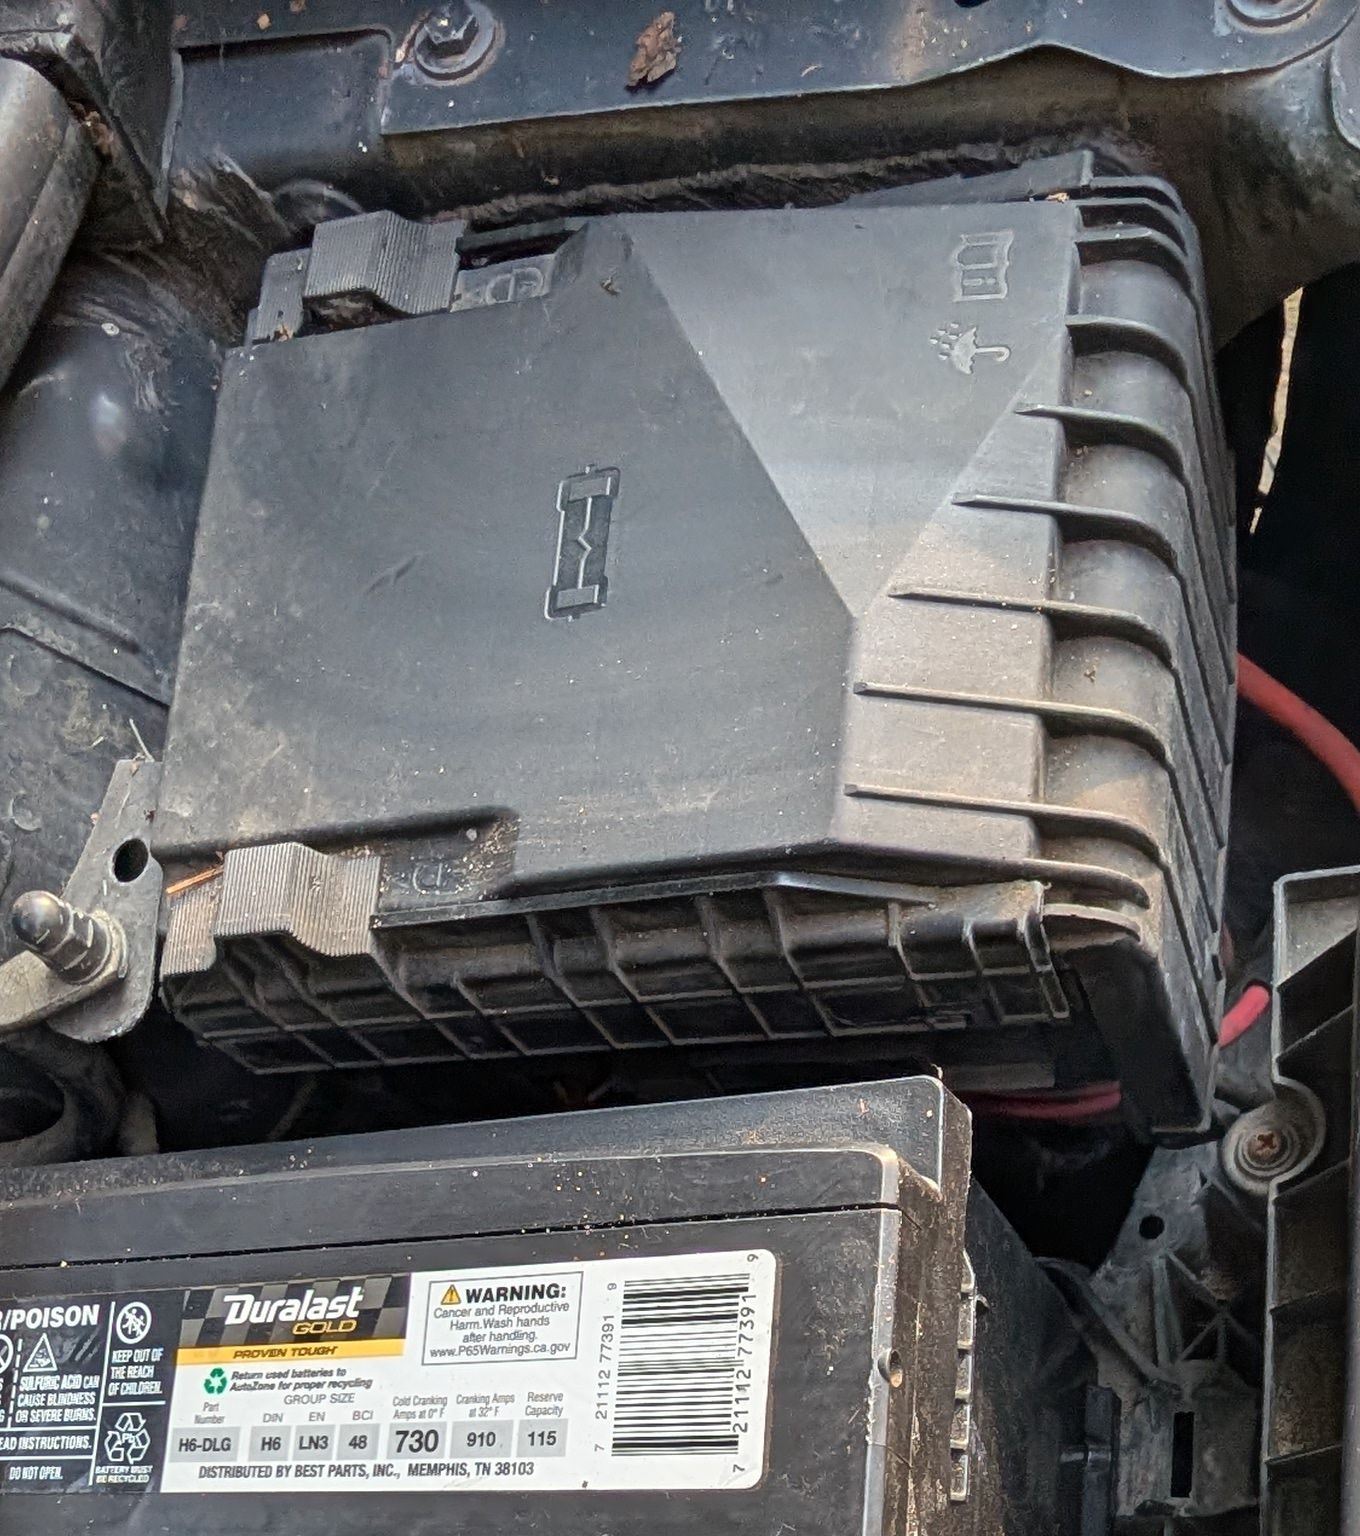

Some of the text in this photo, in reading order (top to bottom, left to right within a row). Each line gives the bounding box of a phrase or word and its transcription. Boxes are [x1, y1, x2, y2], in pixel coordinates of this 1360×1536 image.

[466, 1283, 566, 1303] WARNING:
[223, 1286, 366, 1325] Duralast
[434, 1301, 570, 1318] Cancer and Reproductive
[292, 1319, 357, 1335] GOLD
[517, 1316, 550, 1327] hands
[463, 1330, 538, 1343] after handling.
[112, 1348, 164, 1363] KEEP OUT OF
[233, 1346, 338, 1359] PROVEN TOUGH
[430, 1342, 570, 1358] www.P65Warnings.ca.gov
[594, 1282, 617, 1453] 7 21112 77391 9
[732, 1253, 760, 1474] 7 21112 77391 9
[111, 1365, 154, 1379] THE REACH
[231, 1368, 346, 1381] Return used batteries to
[61, 1374, 82, 1389] ACID
[83, 1375, 100, 1388] CAN
[230, 1378, 373, 1392] AutoZone for proper recycling
[108, 1382, 120, 1396] OF
[18, 1392, 96, 1407] CAUSE BLINDNESS
[284, 1393, 355, 1405] GROUP SIZE
[393, 1395, 448, 1407] Cold Cranking
[456, 1393, 515, 1405] Cranking Amps
[528, 1392, 564, 1402] Reserve
[203, 1402, 219, 1412] Part
[393, 1409, 416, 1420] Amps
[418, 1408, 426, 1417] at
[439, 1408, 445, 1417] F
[469, 1408, 476, 1417] at
[495, 1406, 499, 1416] F
[525, 1406, 563, 1417] Capacity
[16, 1410, 28, 1423] OR
[30, 1408, 62, 1422] SEVERE
[195, 1415, 225, 1424] Number
[263, 1414, 284, 1423] DIN
[309, 1412, 325, 1421] EN
[353, 1411, 373, 1420] BCI
[19, 1435, 92, 1450] INSTRUCTIONS.
[122, 1433, 135, 1443] Pb
[178, 1437, 232, 1452] H6-DLG
[261, 1435, 281, 1451] H6
[299, 1435, 329, 1450] LN3
[349, 1435, 368, 1449] 48
[395, 1429, 439, 1453] 730
[467, 1432, 496, 1447] 910
[528, 1431, 557, 1446] 115
[9, 1466, 63, 1480] DO NOT OPEN.
[199, 1462, 534, 1479] DISTRIBUTED BY BEST PARTS, INC., MEMPHIS, TN 38103
